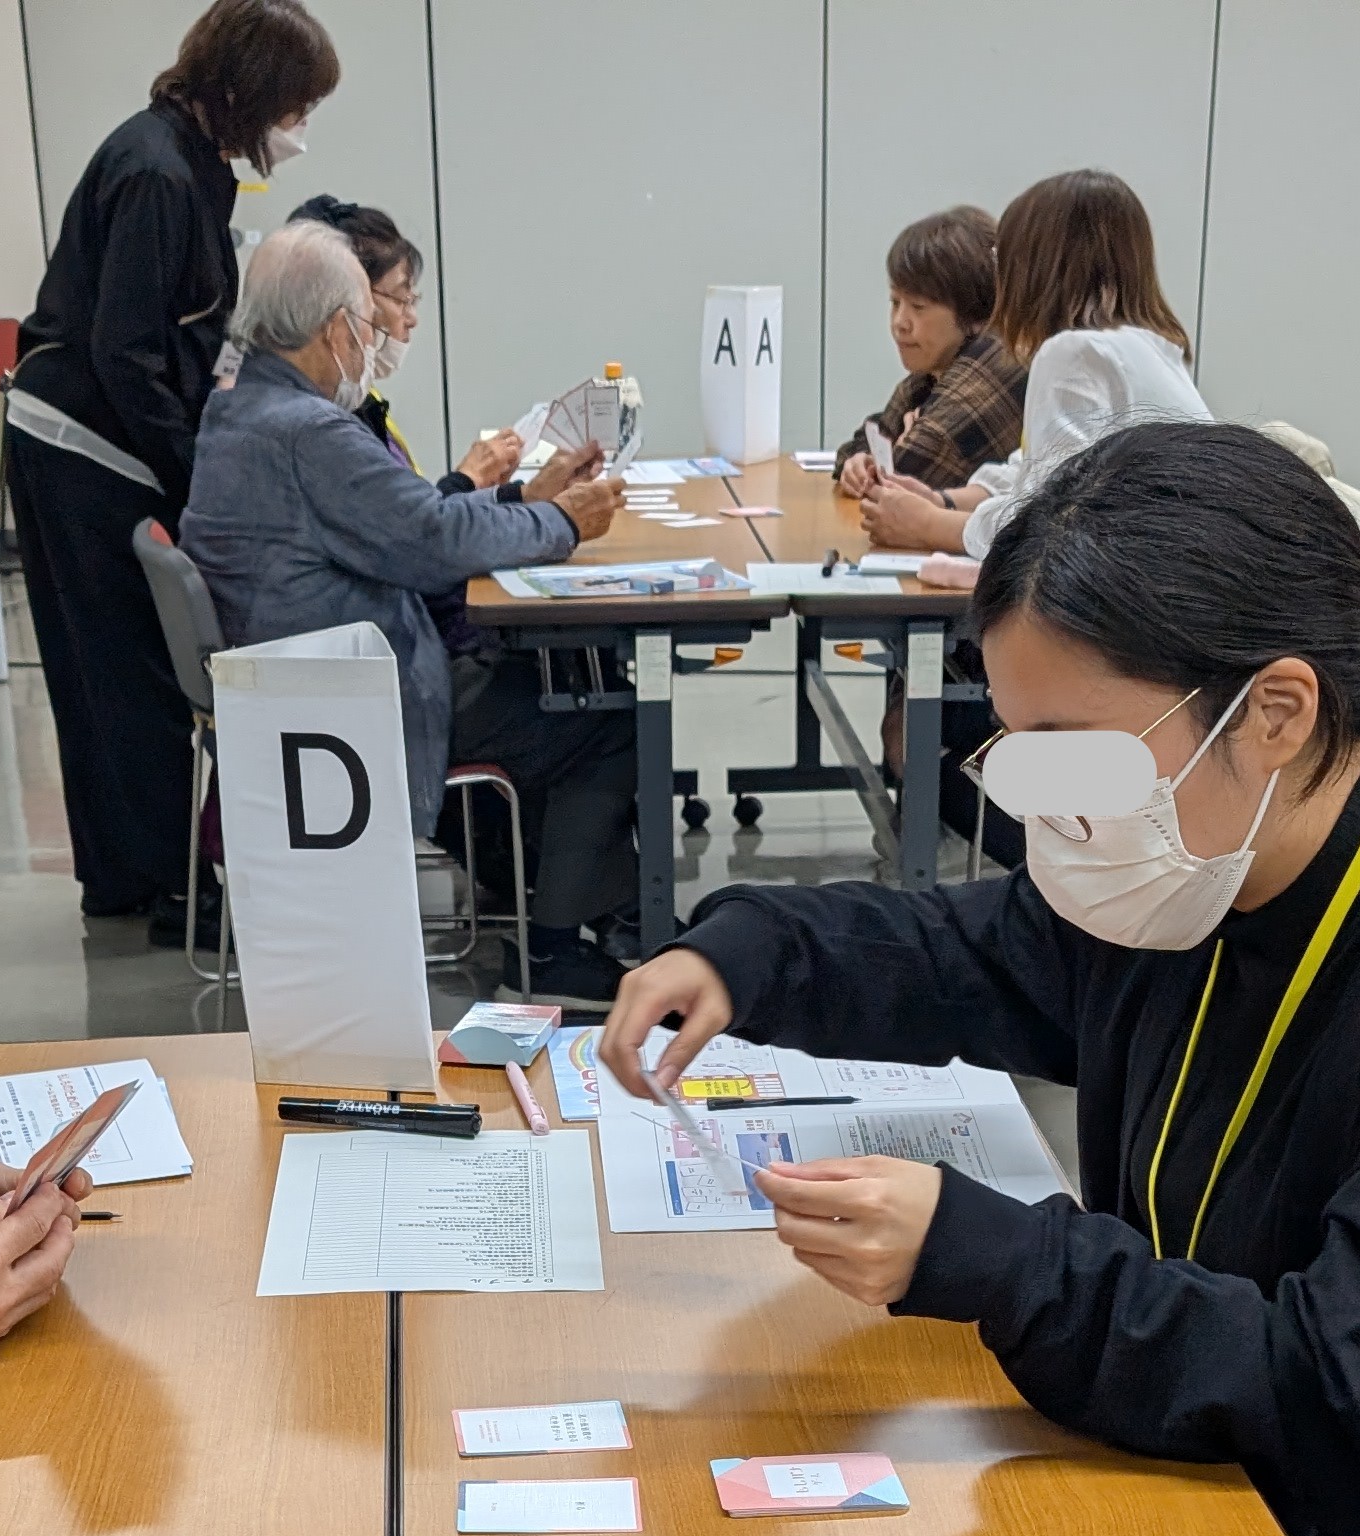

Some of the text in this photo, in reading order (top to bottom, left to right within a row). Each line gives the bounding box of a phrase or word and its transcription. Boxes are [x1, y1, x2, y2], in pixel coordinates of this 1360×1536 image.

[713, 317, 737, 366] A
[755, 317, 774, 366] A
[280, 731, 372, 851] D
